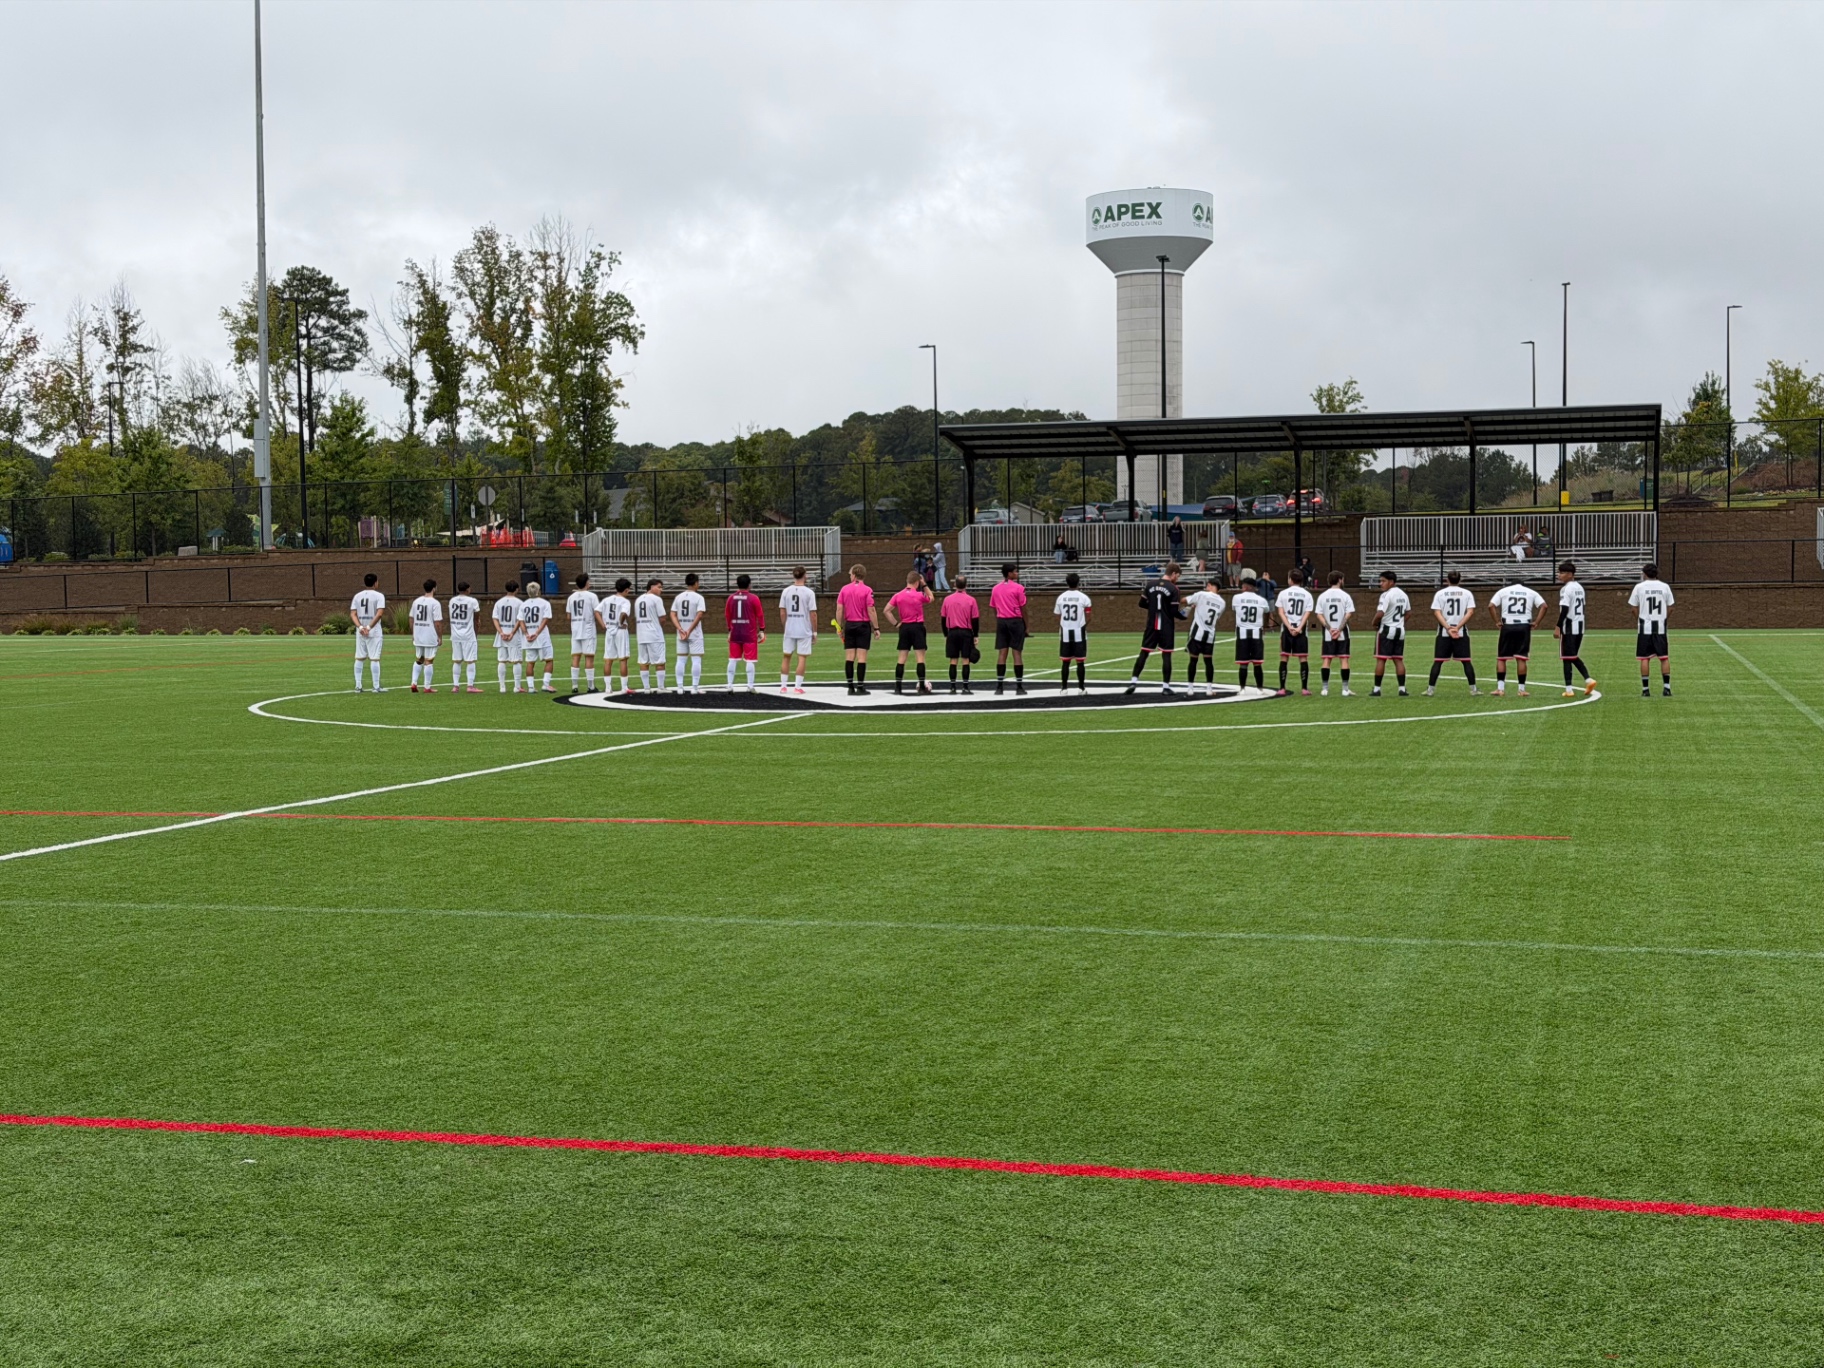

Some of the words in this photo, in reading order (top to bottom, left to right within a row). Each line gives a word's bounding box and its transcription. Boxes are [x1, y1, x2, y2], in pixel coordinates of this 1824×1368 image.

[1103, 202, 1162, 222] APEX
[361, 598, 369, 614] 4
[573, 599, 584, 616] 19
[639, 601, 647, 618] 8
[681, 600, 689, 617] 9
[737, 600, 742, 618] 1
[791, 594, 800, 612] 3
[1156, 594, 1161, 610] 1
[1287, 598, 1304, 616] 30
[1447, 598, 1460, 616] 31
[1508, 597, 1527, 614] 23
[1646, 596, 1661, 615] 14
[416, 604, 428, 621] 31
[501, 605, 512, 622] 10
[524, 606, 540, 623] 26
[609, 603, 616, 620] 5
[1063, 604, 1078, 621] 33
[1204, 608, 1216, 626] 3
[1240, 605, 1257, 623] 39
[1329, 604, 1338, 622] 2
